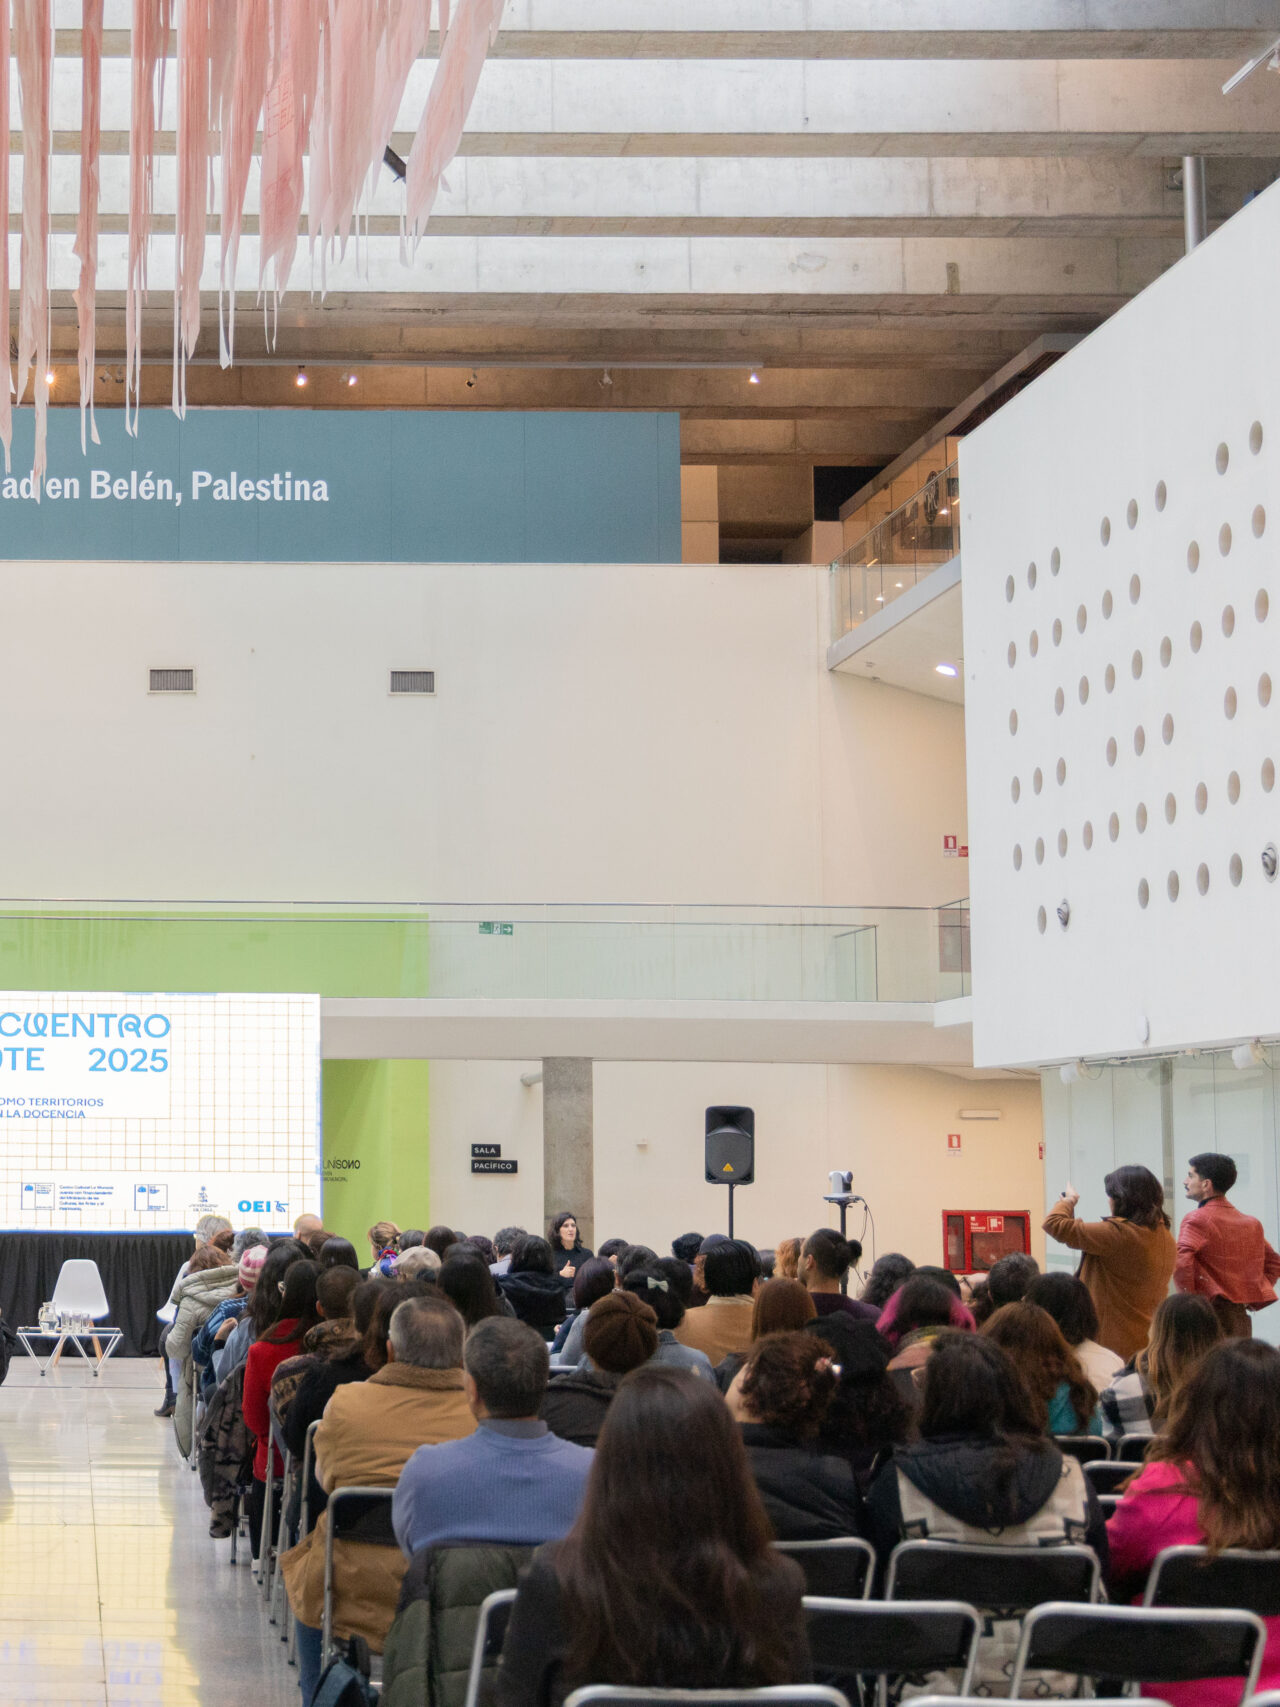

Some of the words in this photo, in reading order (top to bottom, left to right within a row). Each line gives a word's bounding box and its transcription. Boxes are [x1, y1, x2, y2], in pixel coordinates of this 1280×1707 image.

[46, 477, 81, 501] en
[90, 470, 182, 507] Belén,
[192, 470, 329, 502] Palestina
[88, 1047, 169, 1073] 2025
[28, 1097, 104, 1107] TERRITORIOS
[6, 1109, 21, 1118] LA
[23, 1109, 86, 1119] DOCENCIA
[474, 1161, 512, 1170] PACÍFICO
[237, 1199, 272, 1213] OEI
